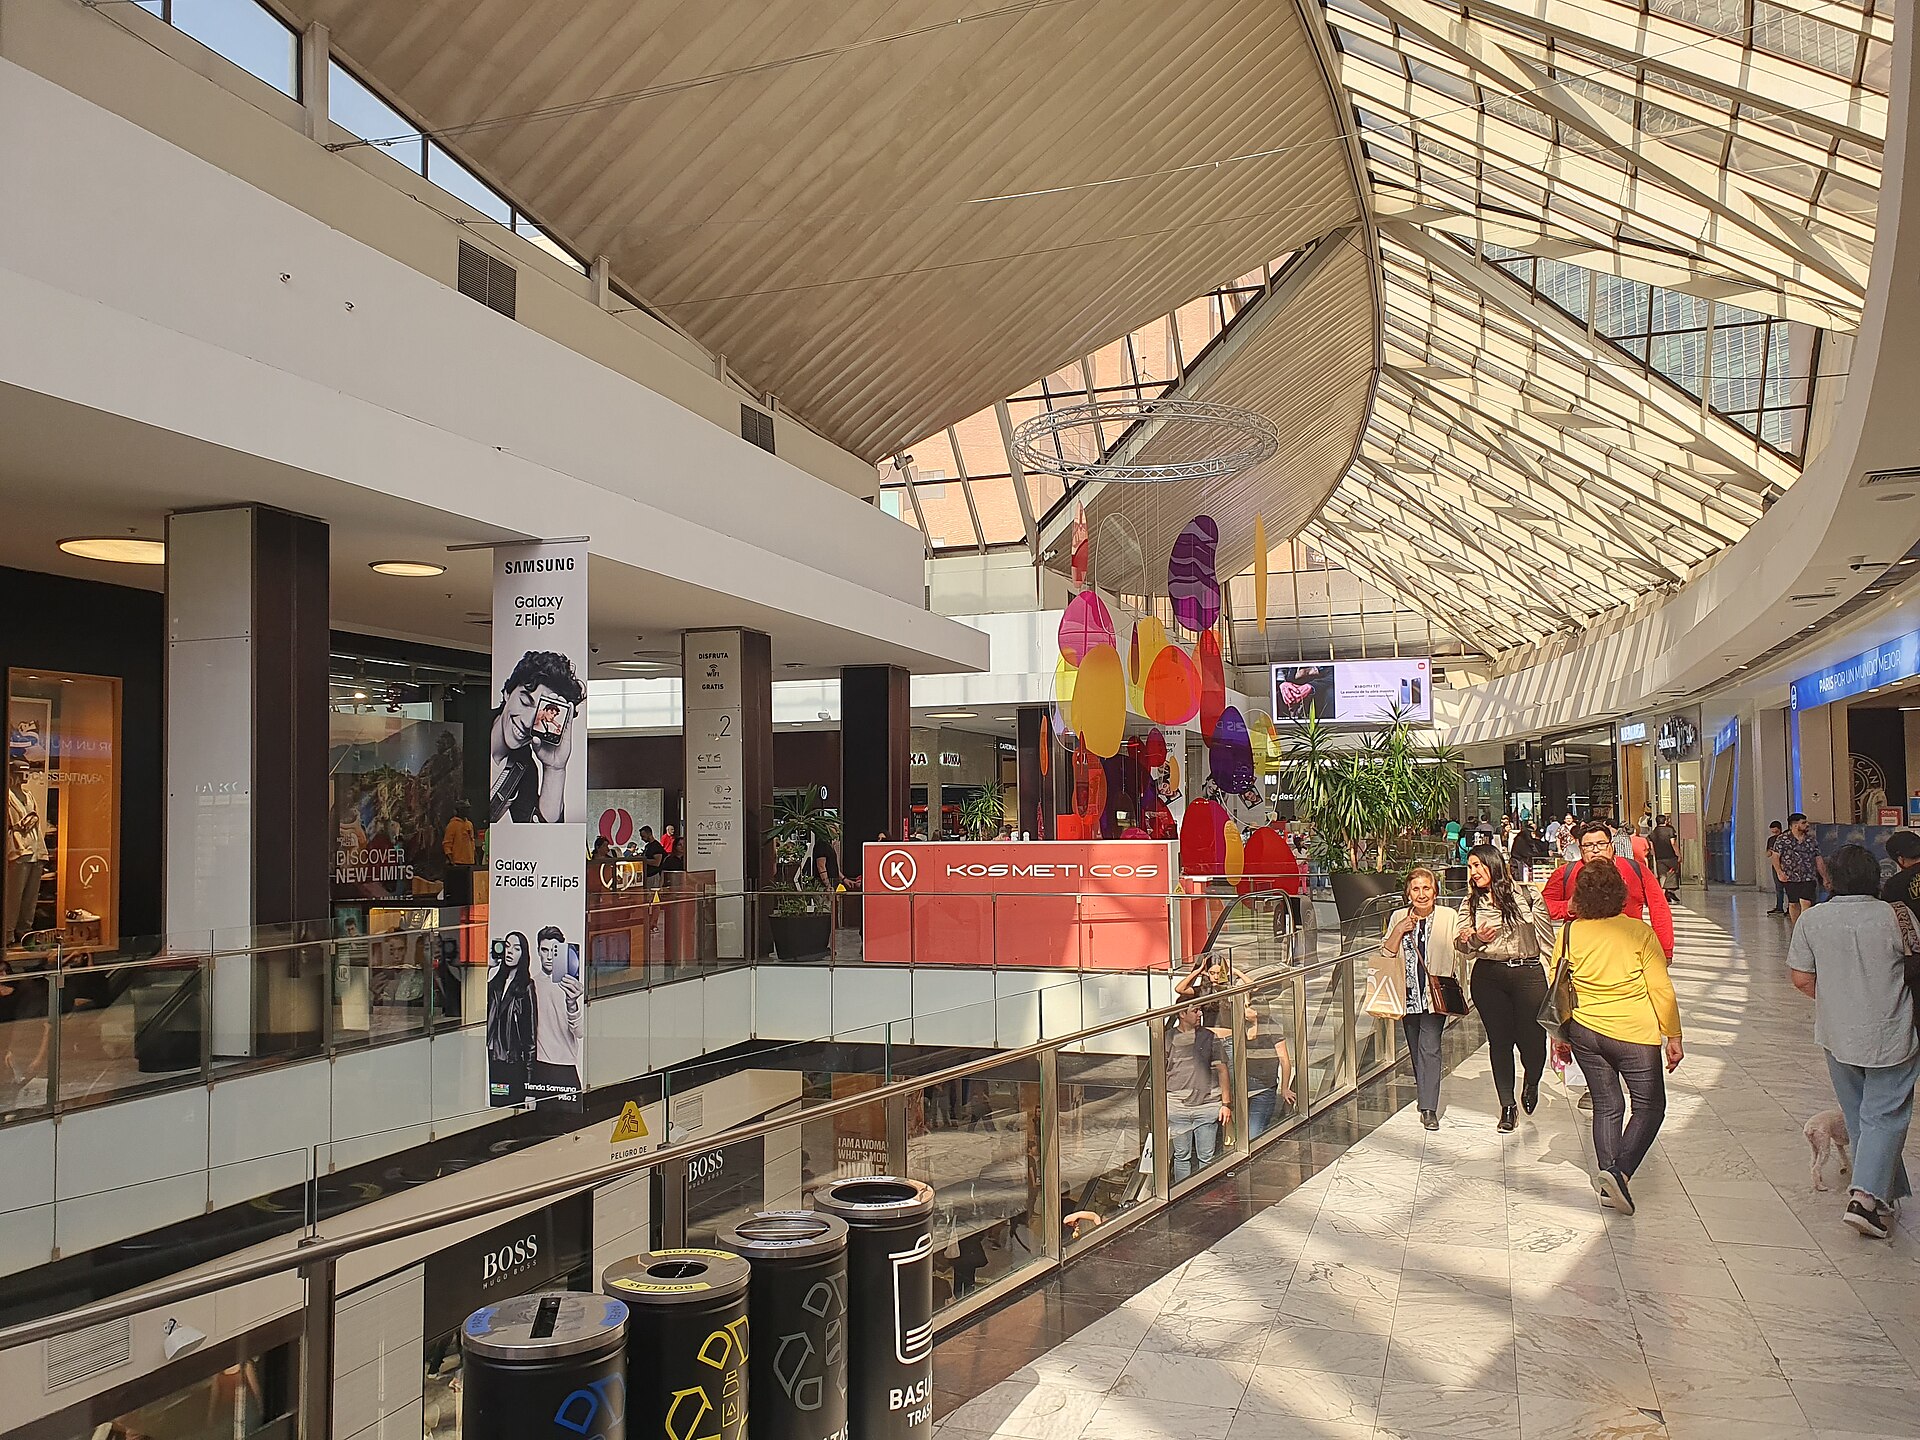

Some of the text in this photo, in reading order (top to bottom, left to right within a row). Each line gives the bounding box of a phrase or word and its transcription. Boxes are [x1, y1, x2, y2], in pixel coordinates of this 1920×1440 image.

[505, 557, 575, 574] SAMSUNG
[514, 594, 563, 610] Galaxy
[515, 612, 555, 629] Z Flip5
[1820, 650, 1900, 693] PARIS POR UN MUNDO MEJOR
[720, 715, 731, 736] 2
[1544, 746, 1564, 766] LUSH
[336, 848, 405, 866] DISCOVER
[336, 864, 414, 884] NEW LIMITS
[495, 859, 538, 874] Galaxy
[946, 864, 1158, 878] KOSMETICOS
[495, 876, 579, 892] Z Fold5 Z Flip5
[524, 1082, 546, 1092] Tienda
[838, 1137, 888, 1150] I AM A WOMA
[610, 1146, 648, 1160] PELIGRO DE
[838, 1149, 868, 1162] WHAT'S
[688, 1149, 724, 1182] BOSS
[838, 1161, 888, 1178] DIVINE
[688, 1170, 724, 1190] HUGO BOSS
[482, 1234, 538, 1280] BOSS
[482, 1260, 536, 1290] HUGO BOSS
[628, 1282, 694, 1290] BOTELLAS
